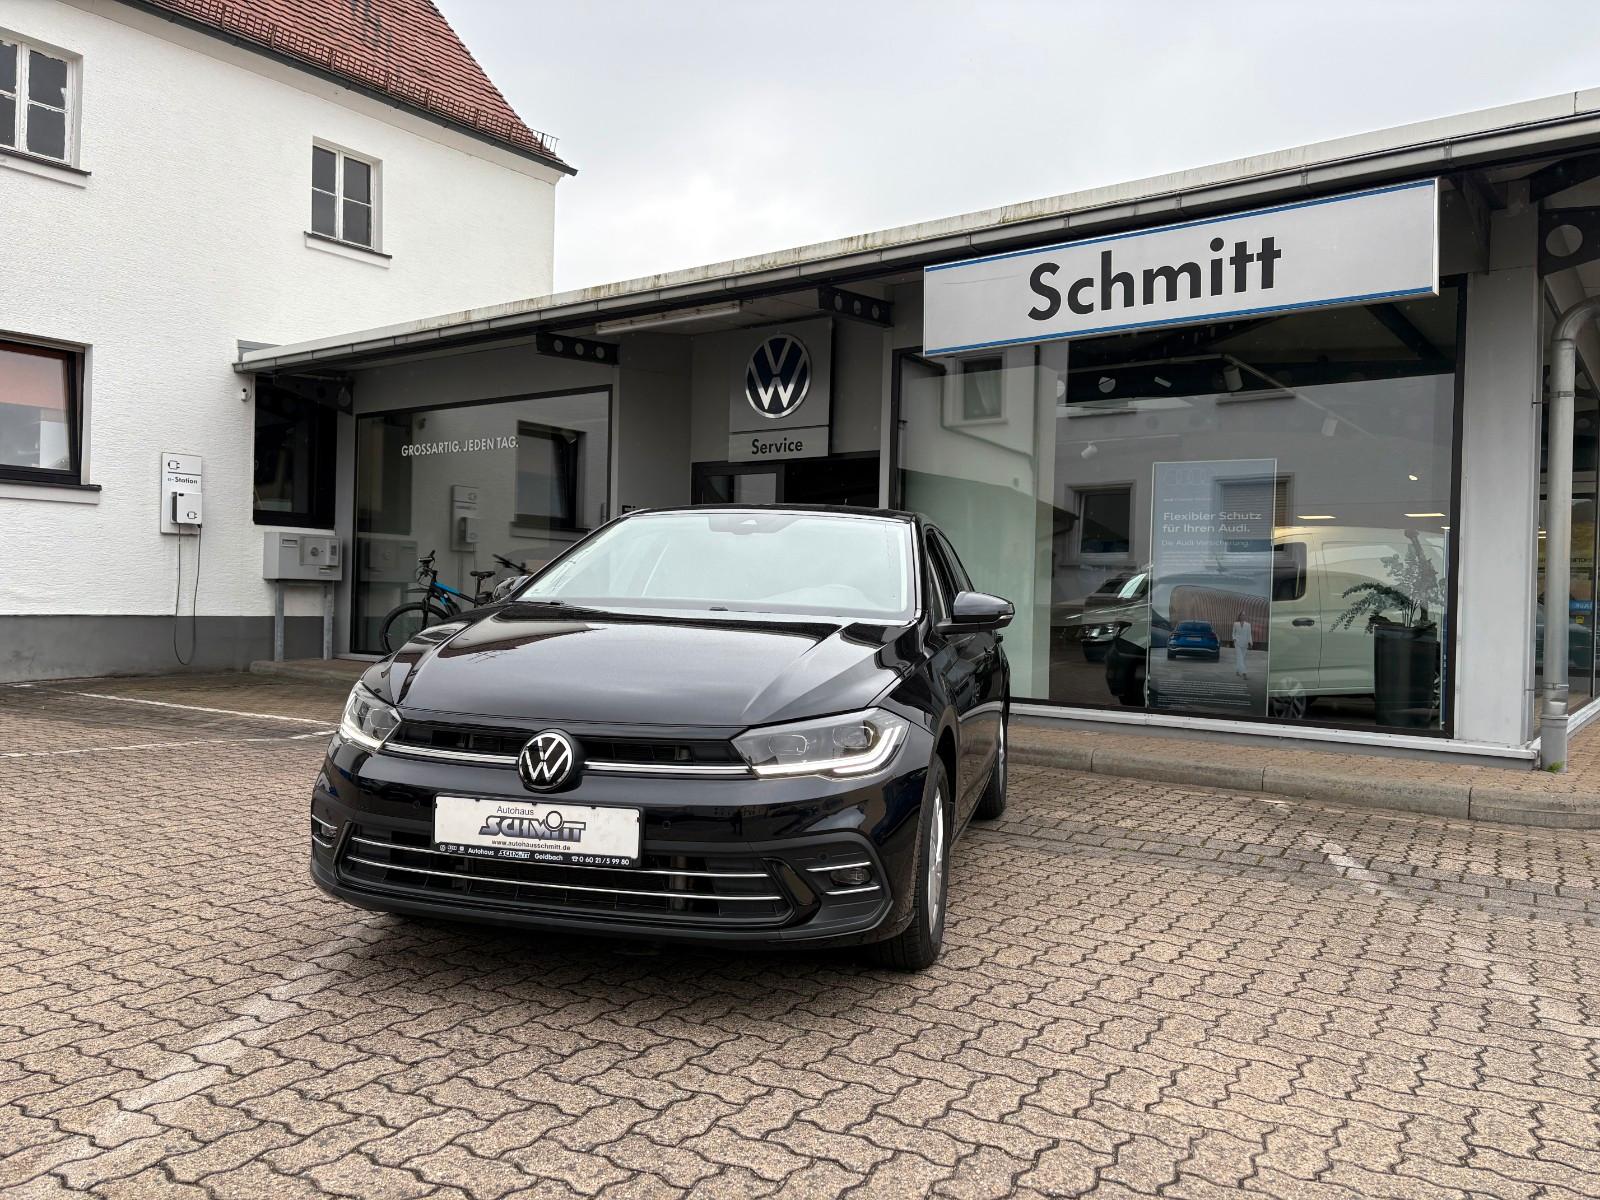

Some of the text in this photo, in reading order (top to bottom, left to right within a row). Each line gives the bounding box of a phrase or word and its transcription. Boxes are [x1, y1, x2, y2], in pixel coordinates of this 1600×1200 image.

[1027, 237, 1282, 321] Schmitt
[401, 435, 519, 457] GROSSARTIG. JEDEN TAG.
[751, 437, 804, 455] Service
[1163, 511, 1262, 521] Flexibler Schutz
[1162, 523, 1250, 533] für Ihren Audi.
[496, 805, 535, 817] Autohaus
[491, 840, 571, 851] www.autohausschmitt.de
[468, 847, 494, 856] Autohaus
[534, 853, 563, 861] Goldbach
